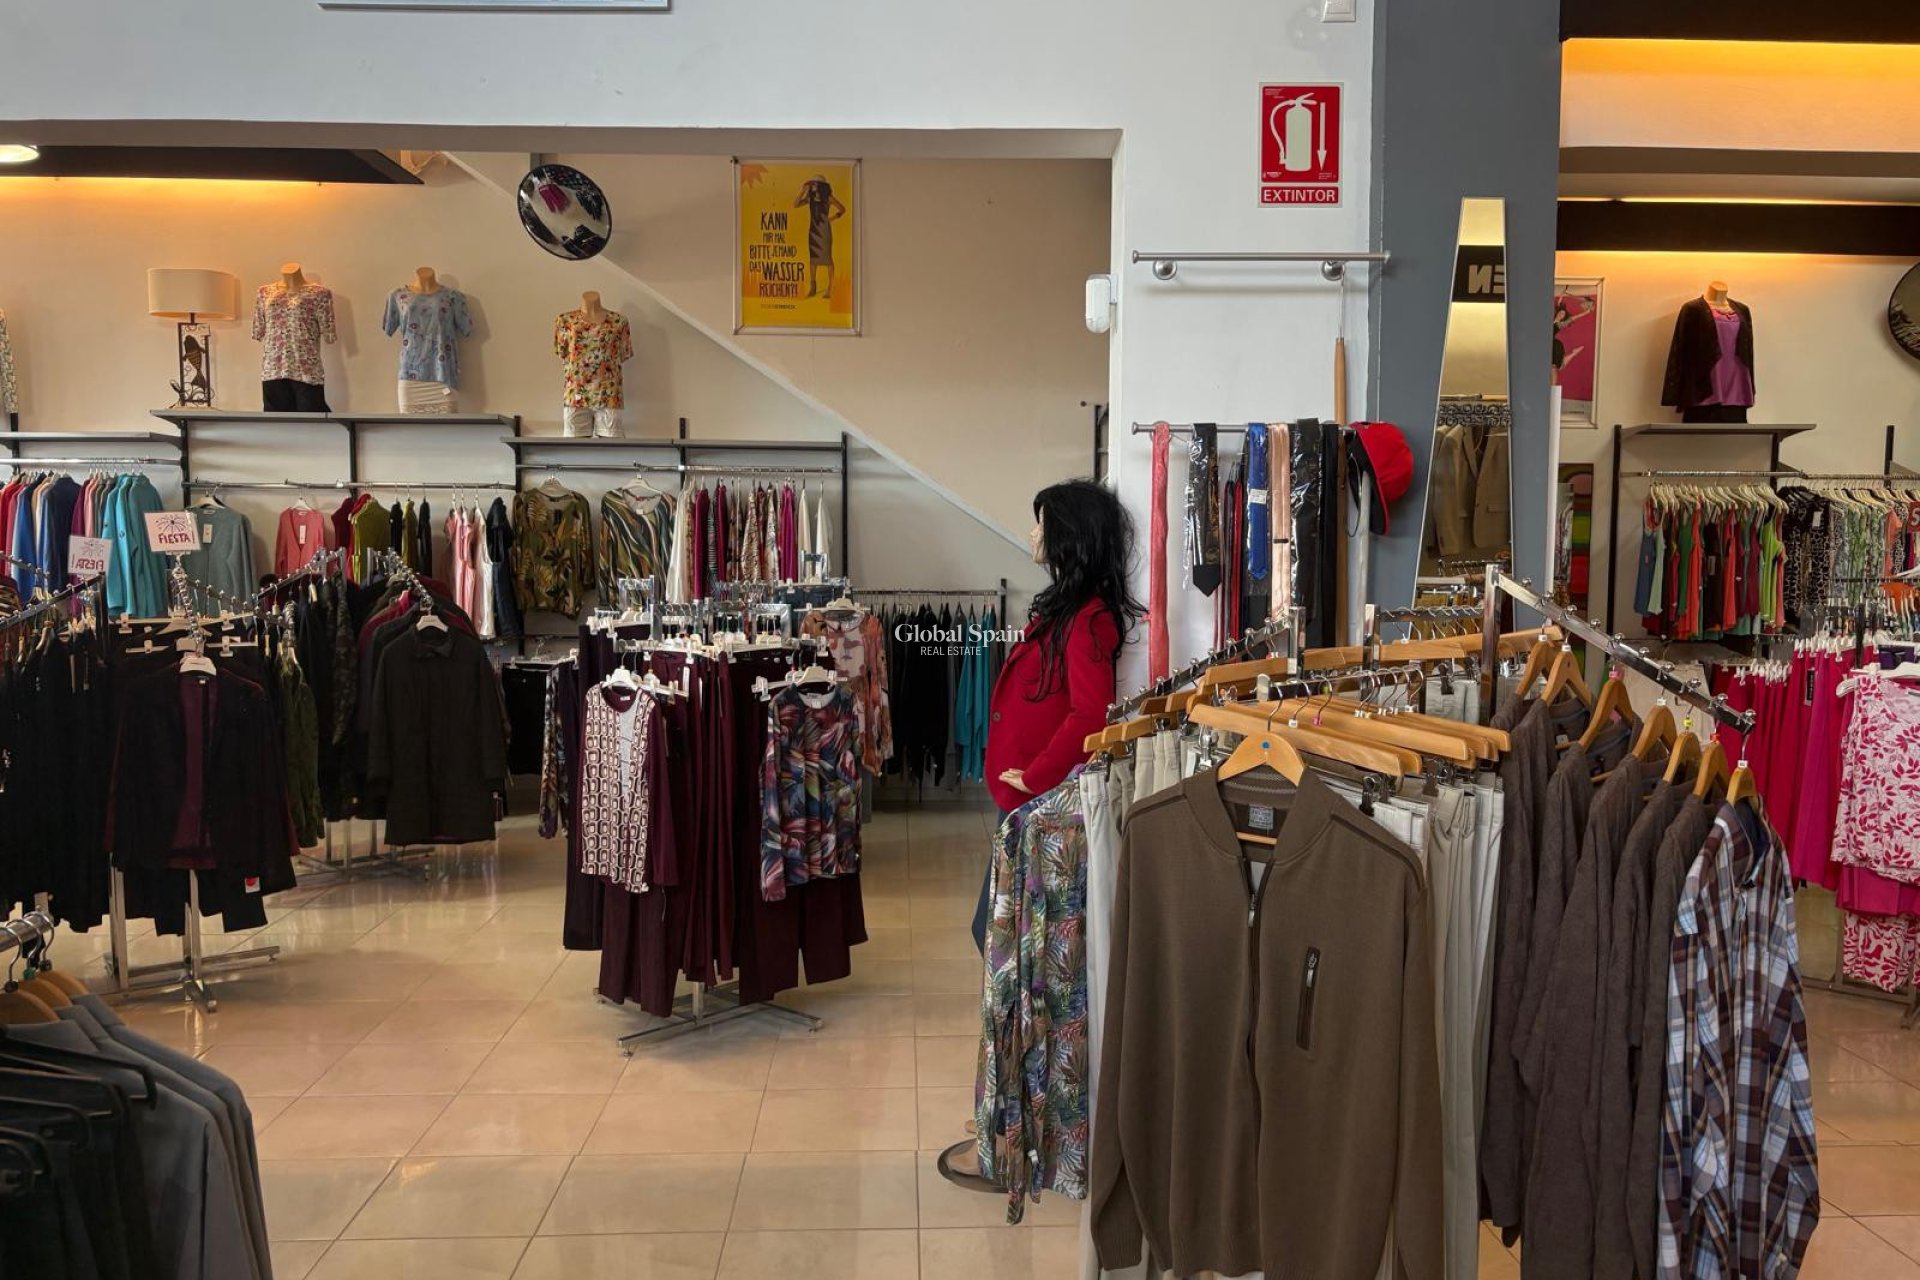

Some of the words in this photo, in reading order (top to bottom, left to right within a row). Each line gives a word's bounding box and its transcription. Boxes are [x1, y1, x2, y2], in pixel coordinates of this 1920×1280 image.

[1263, 189, 1336, 202] EXTINTOR
[761, 211, 788, 231] KANN
[750, 244, 770, 260] BITTE
[749, 261, 761, 272] DAS
[762, 261, 805, 282] WASSER
